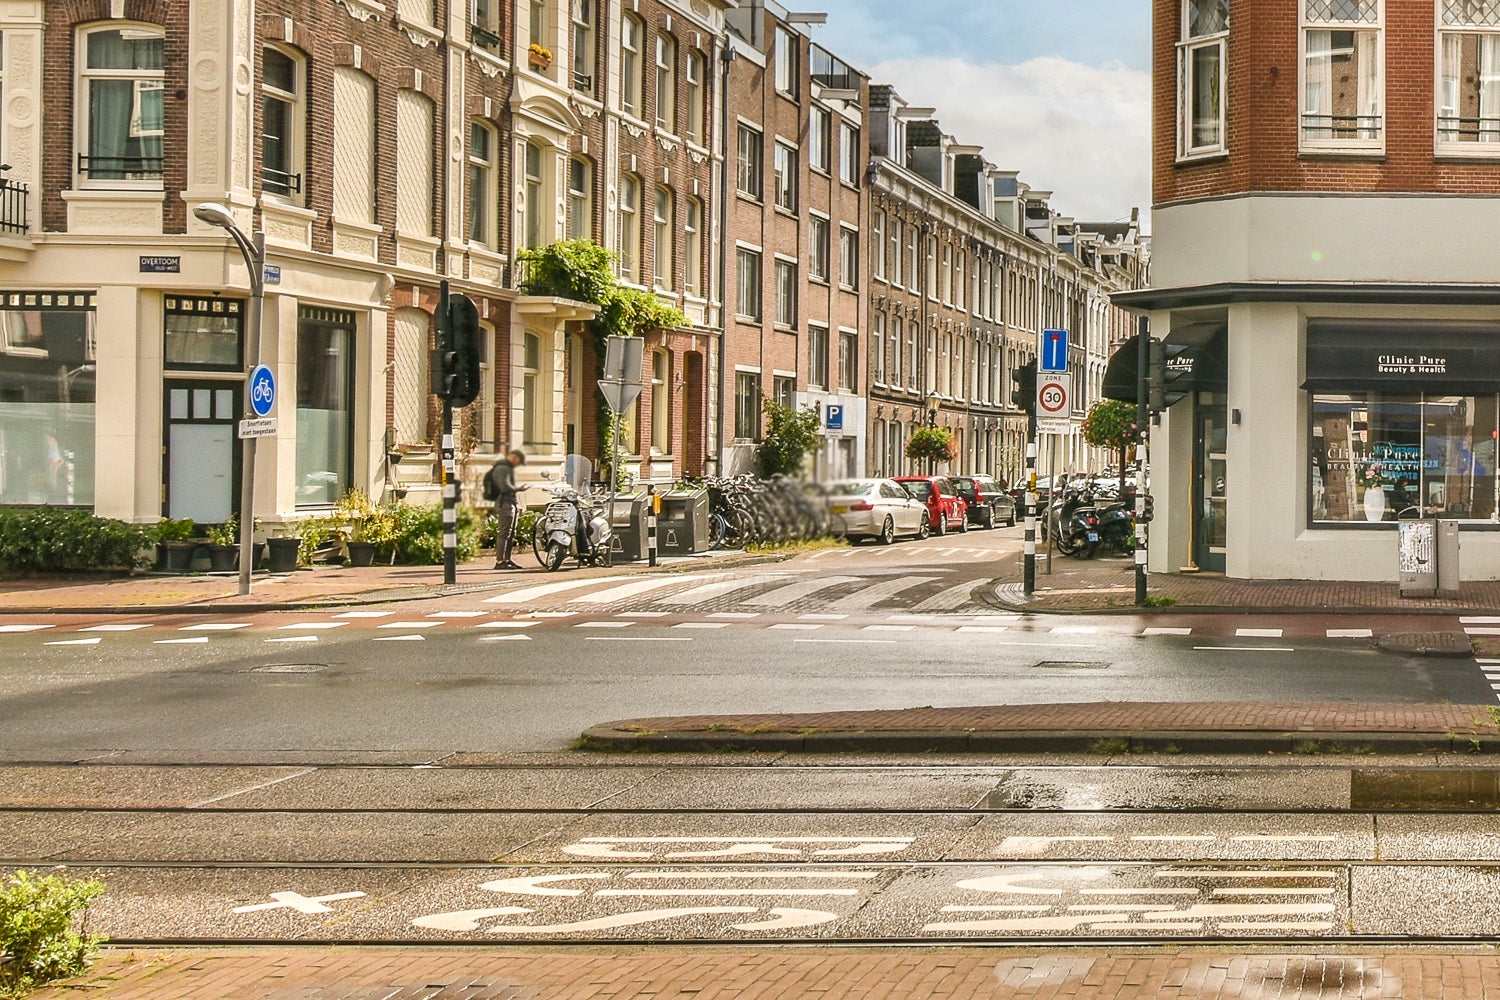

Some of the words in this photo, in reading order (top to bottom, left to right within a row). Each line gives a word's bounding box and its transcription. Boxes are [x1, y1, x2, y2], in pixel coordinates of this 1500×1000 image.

[141, 257, 178, 265] OVERTOOM
[1378, 355, 1414, 364] Clinic
[1419, 355, 1446, 365] Pure
[1378, 366, 1407, 374] Beauty
[1044, 391, 1061, 403] 30
[829, 406, 840, 420] P
[1327, 447, 1375, 459] Clinic
[1384, 448, 1419, 459] Pure
[1381, 463, 1419, 471] HEALTH
[411, 833, 917, 935] BUS
